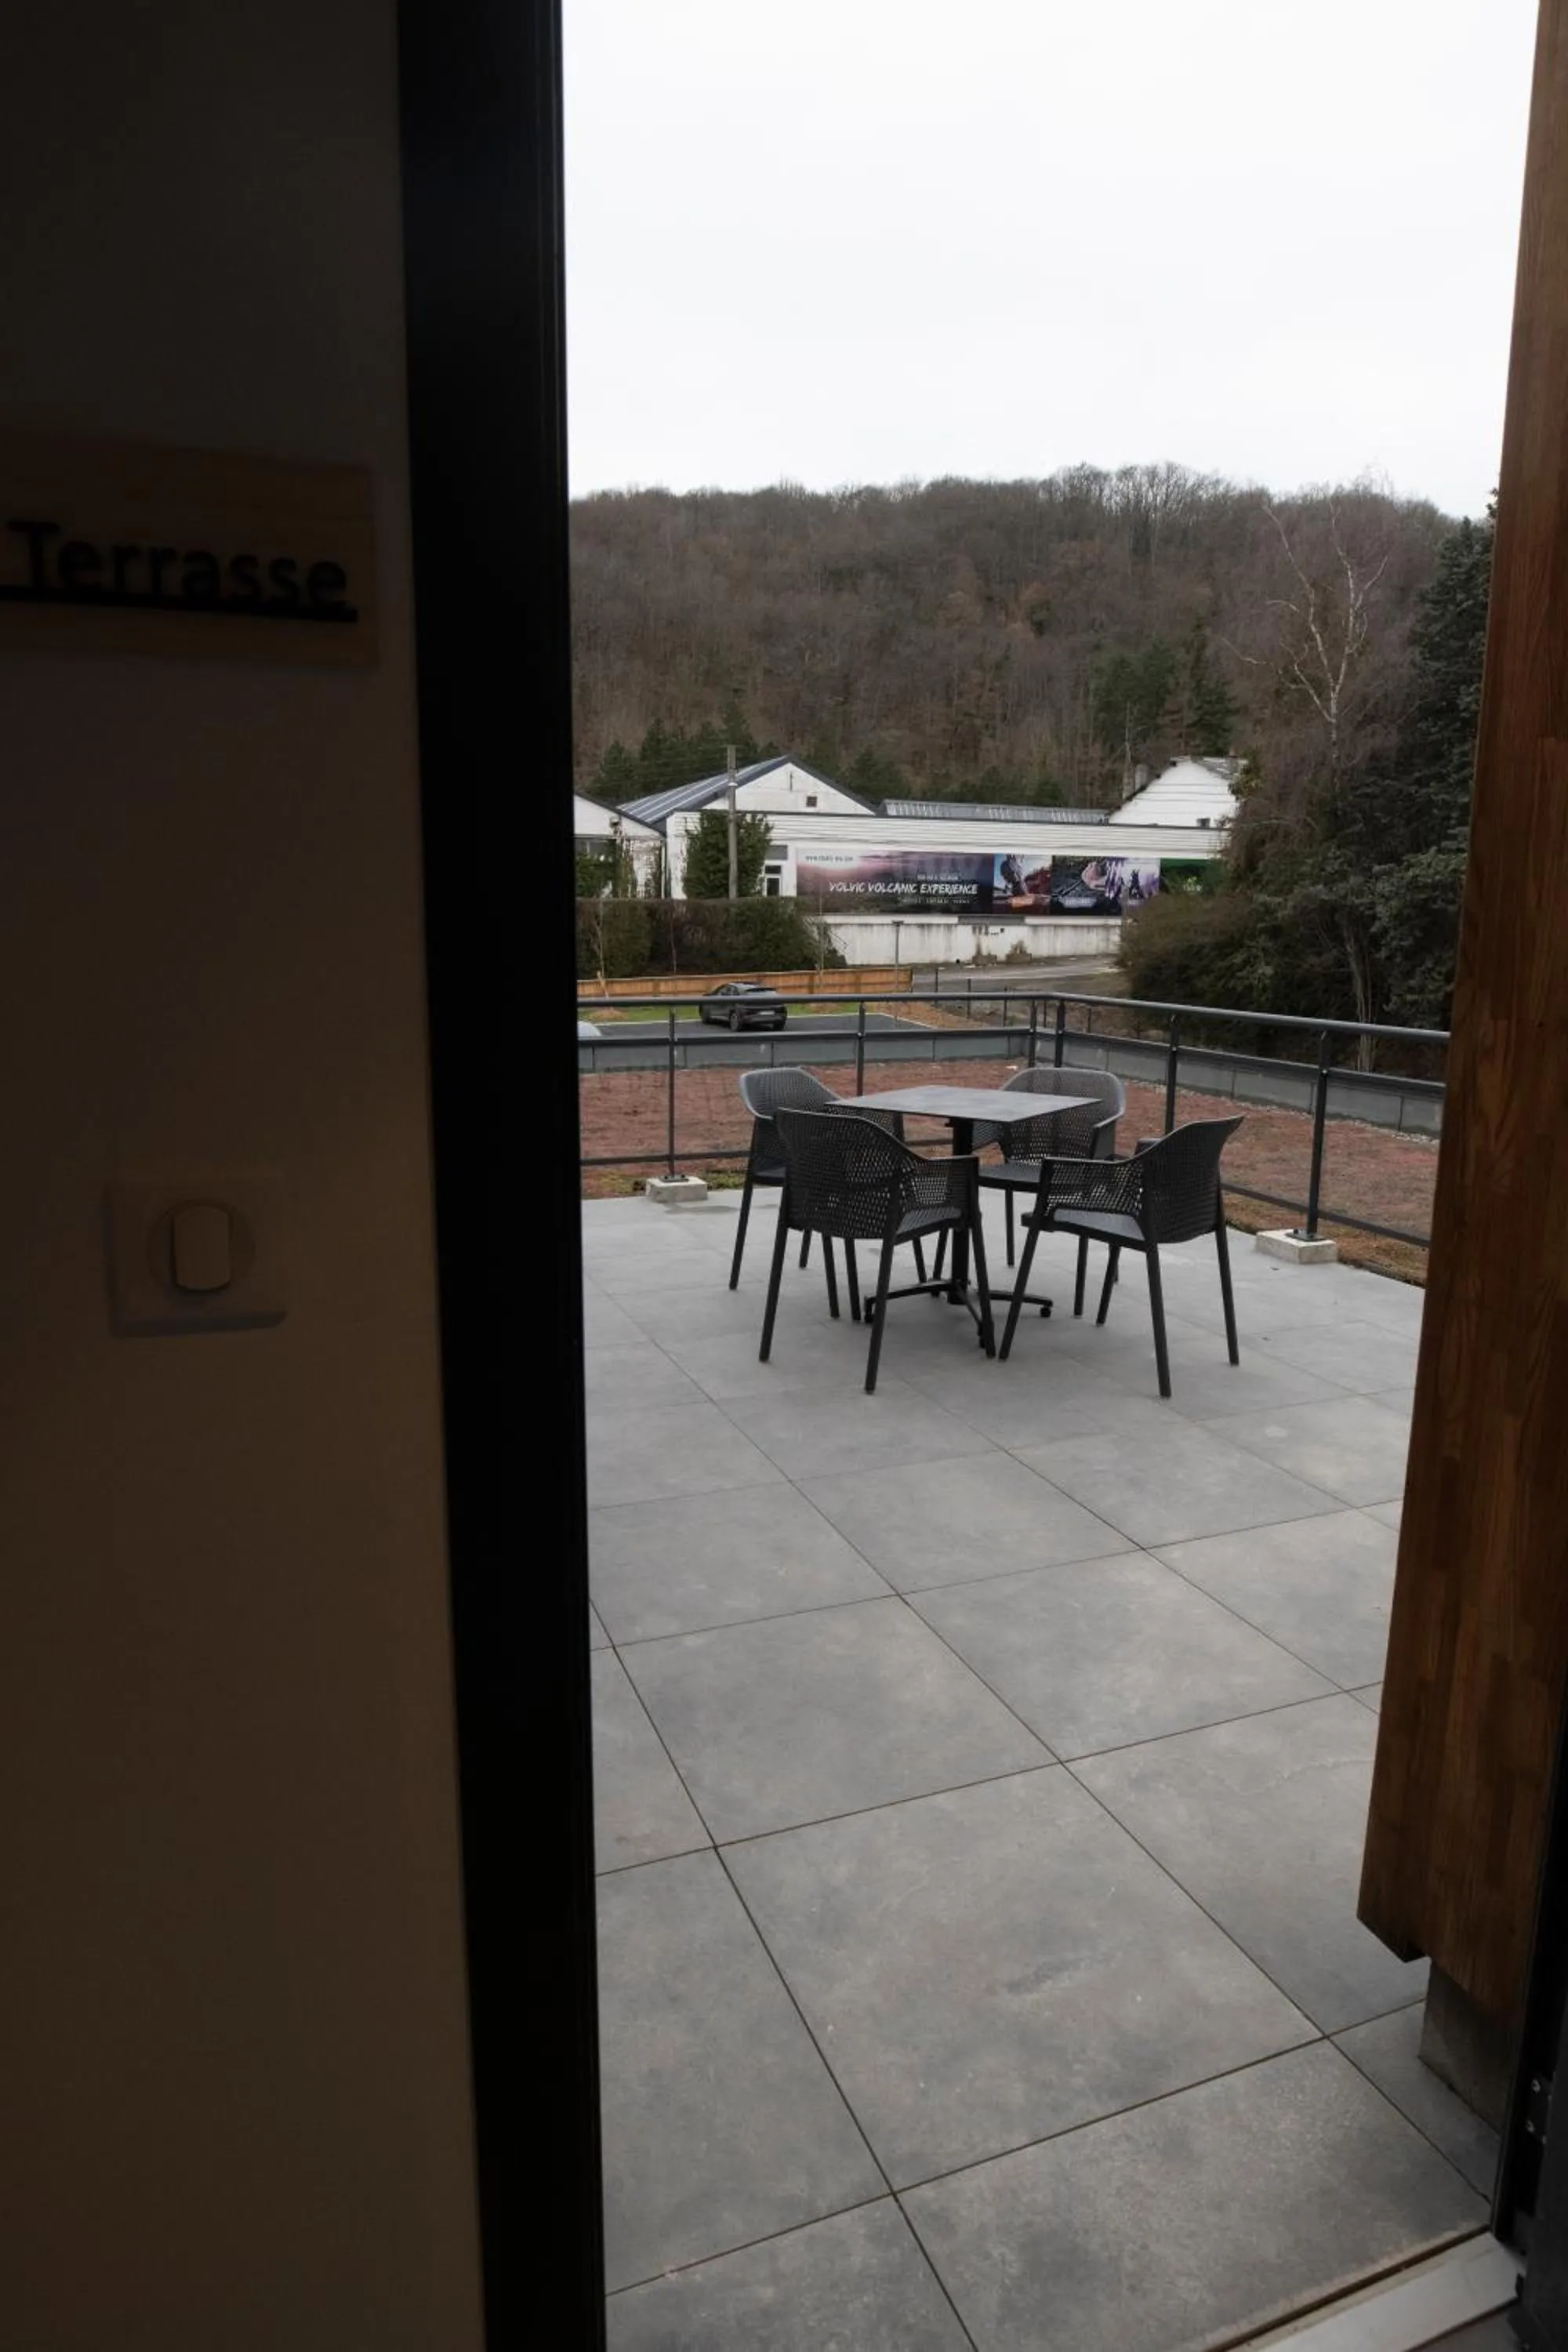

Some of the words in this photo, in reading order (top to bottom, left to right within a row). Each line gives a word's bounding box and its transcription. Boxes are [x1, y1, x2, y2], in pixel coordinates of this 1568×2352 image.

[6, 520, 349, 608] Terrasse
[829, 882, 865, 894] VOLVIC
[868, 883, 917, 895] VOLCANIC
[920, 884, 978, 895] EXPERIENCE
